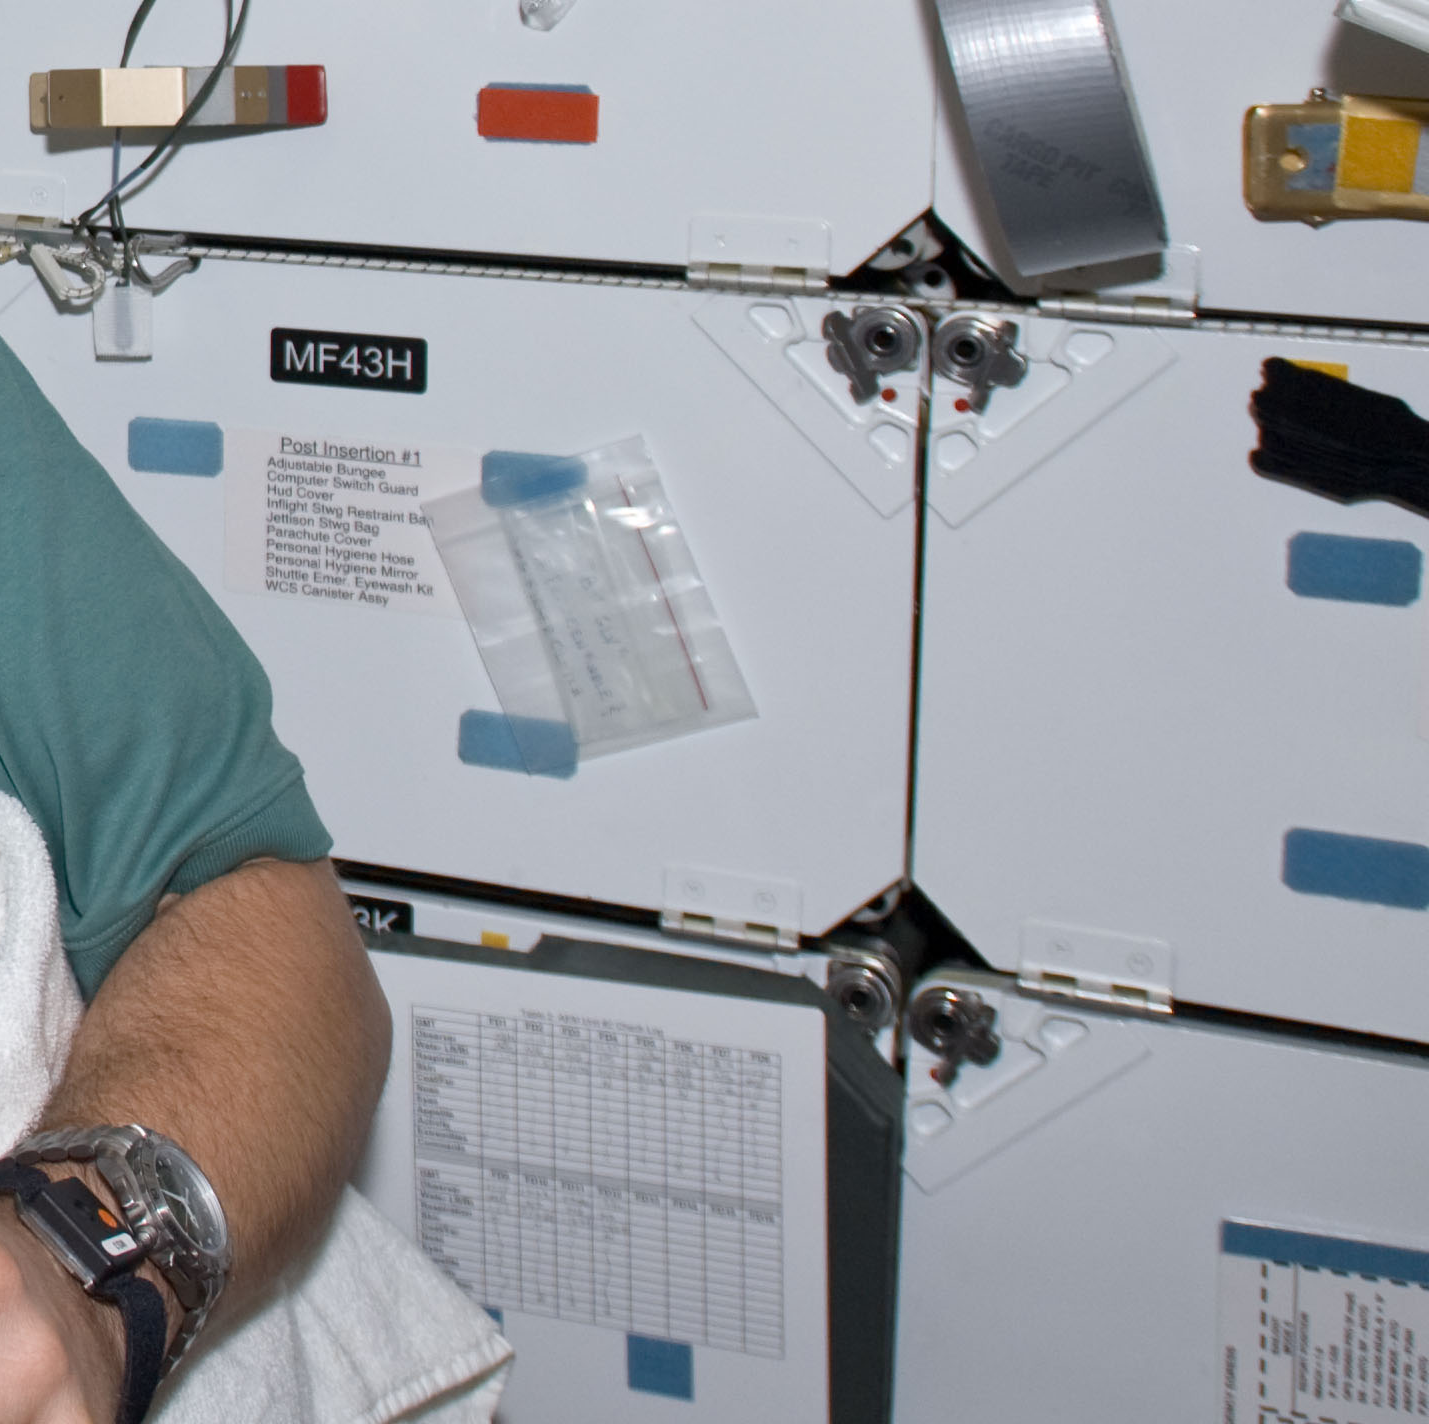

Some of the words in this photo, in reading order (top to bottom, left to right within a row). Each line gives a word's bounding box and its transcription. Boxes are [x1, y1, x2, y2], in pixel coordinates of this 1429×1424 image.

[283, 340, 414, 382] MF43H
[279, 436, 317, 456] Post
[322, 441, 396, 464] Insertion
[400, 449, 422, 466] #1
[267, 456, 333, 474] Adjustable
[336, 463, 386, 480] Bungee
[266, 469, 329, 488] Computer
[332, 476, 375, 492] Switch
[378, 481, 419, 496] Guard
[266, 483, 293, 497] Hud
[296, 486, 335, 501] Cover
[266, 497, 308, 514] Inflight
[311, 502, 344, 518] Stwg
[346, 506, 405, 522] Restraint
[265, 511, 314, 526] Jettison
[318, 516, 351, 532] Stwg
[353, 520, 380, 537] Bag
[266, 524, 330, 541] Parachute
[333, 532, 372, 547] Cover
[265, 538, 321, 555] Personal
[324, 545, 377, 563] Hygiene
[380, 551, 415, 566] Hose
[265, 552, 321, 568] Personal
[324, 559, 377, 577] Hygiene
[380, 565, 419, 580] Mirror
[264, 579, 298, 593] WCS
[301, 583, 355, 600] Canister
[357, 590, 389, 607] Assy
[265, 565, 309, 581] Shuttle
[312, 571, 350, 586] Emer.
[354, 576, 413, 594] Eyewash
[416, 583, 433, 596] Kit
